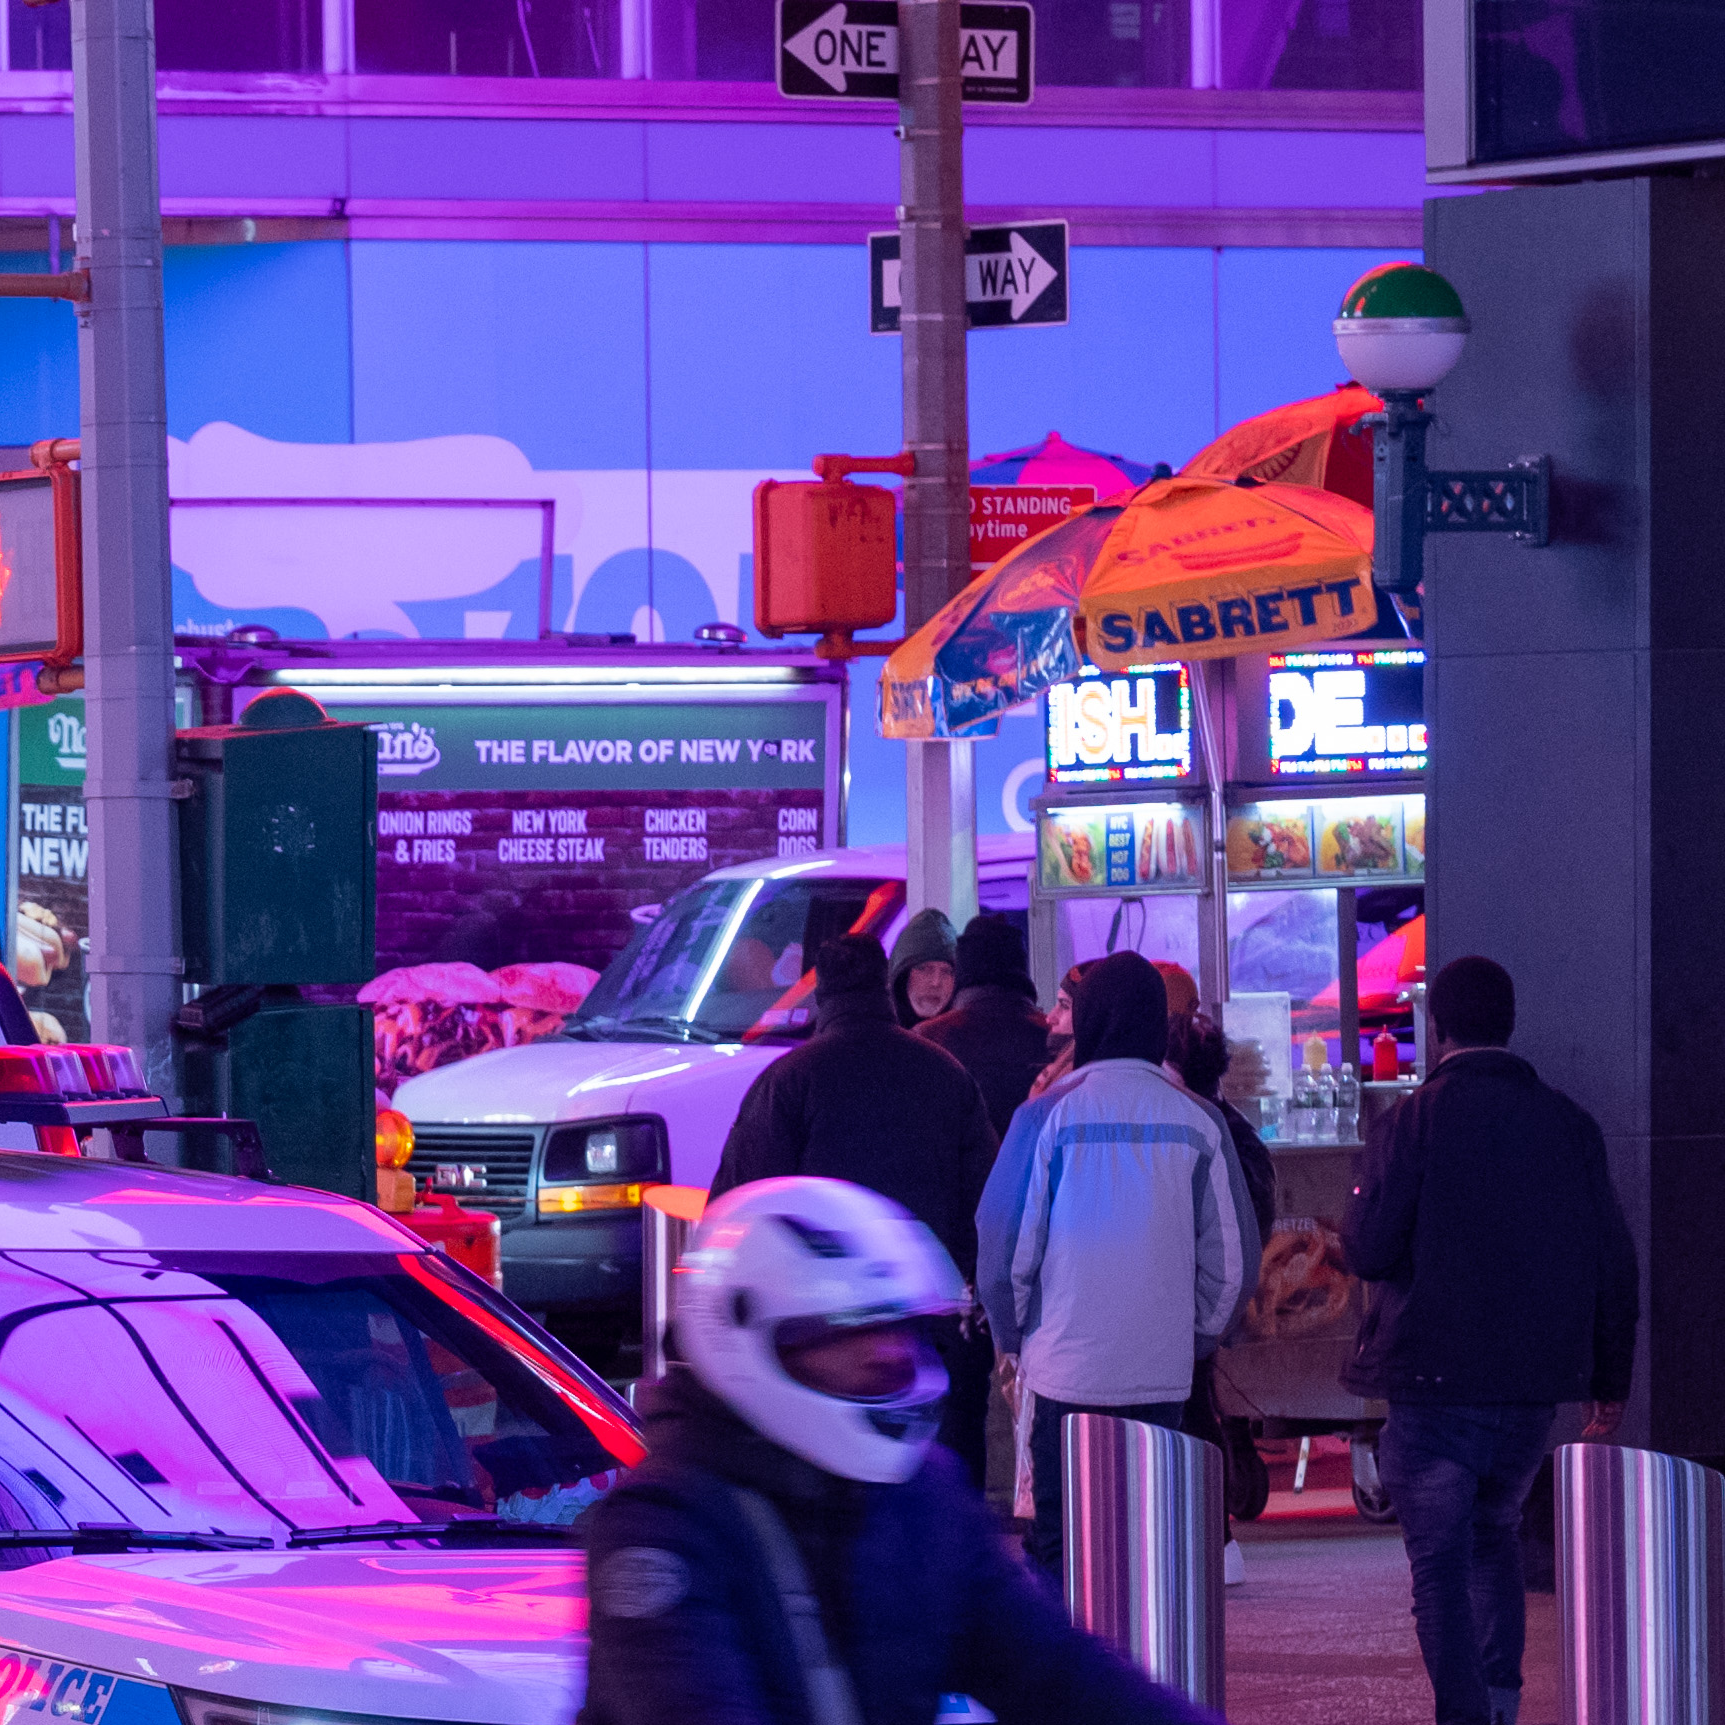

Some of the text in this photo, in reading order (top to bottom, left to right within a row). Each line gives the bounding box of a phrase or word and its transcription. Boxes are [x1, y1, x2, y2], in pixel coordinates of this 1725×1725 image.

[814, 28, 1008, 72] ONE AY
[978, 256, 1037, 297] WAY
[981, 495, 1071, 516] STANDING
[1099, 577, 1362, 654] SABRETT
[474, 738, 817, 764] THE FLAVOR OF NEW YRK
[21, 803, 61, 834] THE
[378, 809, 473, 836] ONION RINGS
[511, 809, 589, 835] NEW YORK
[644, 808, 708, 834] CHICKEN
[777, 807, 818, 833] CORN
[20, 836, 89, 879] NEW
[395, 838, 457, 864] & FRIES
[498, 837, 606, 863] CHEESE STEAK
[642, 836, 709, 862] TENDERS
[435, 1162, 488, 1189] GMC
